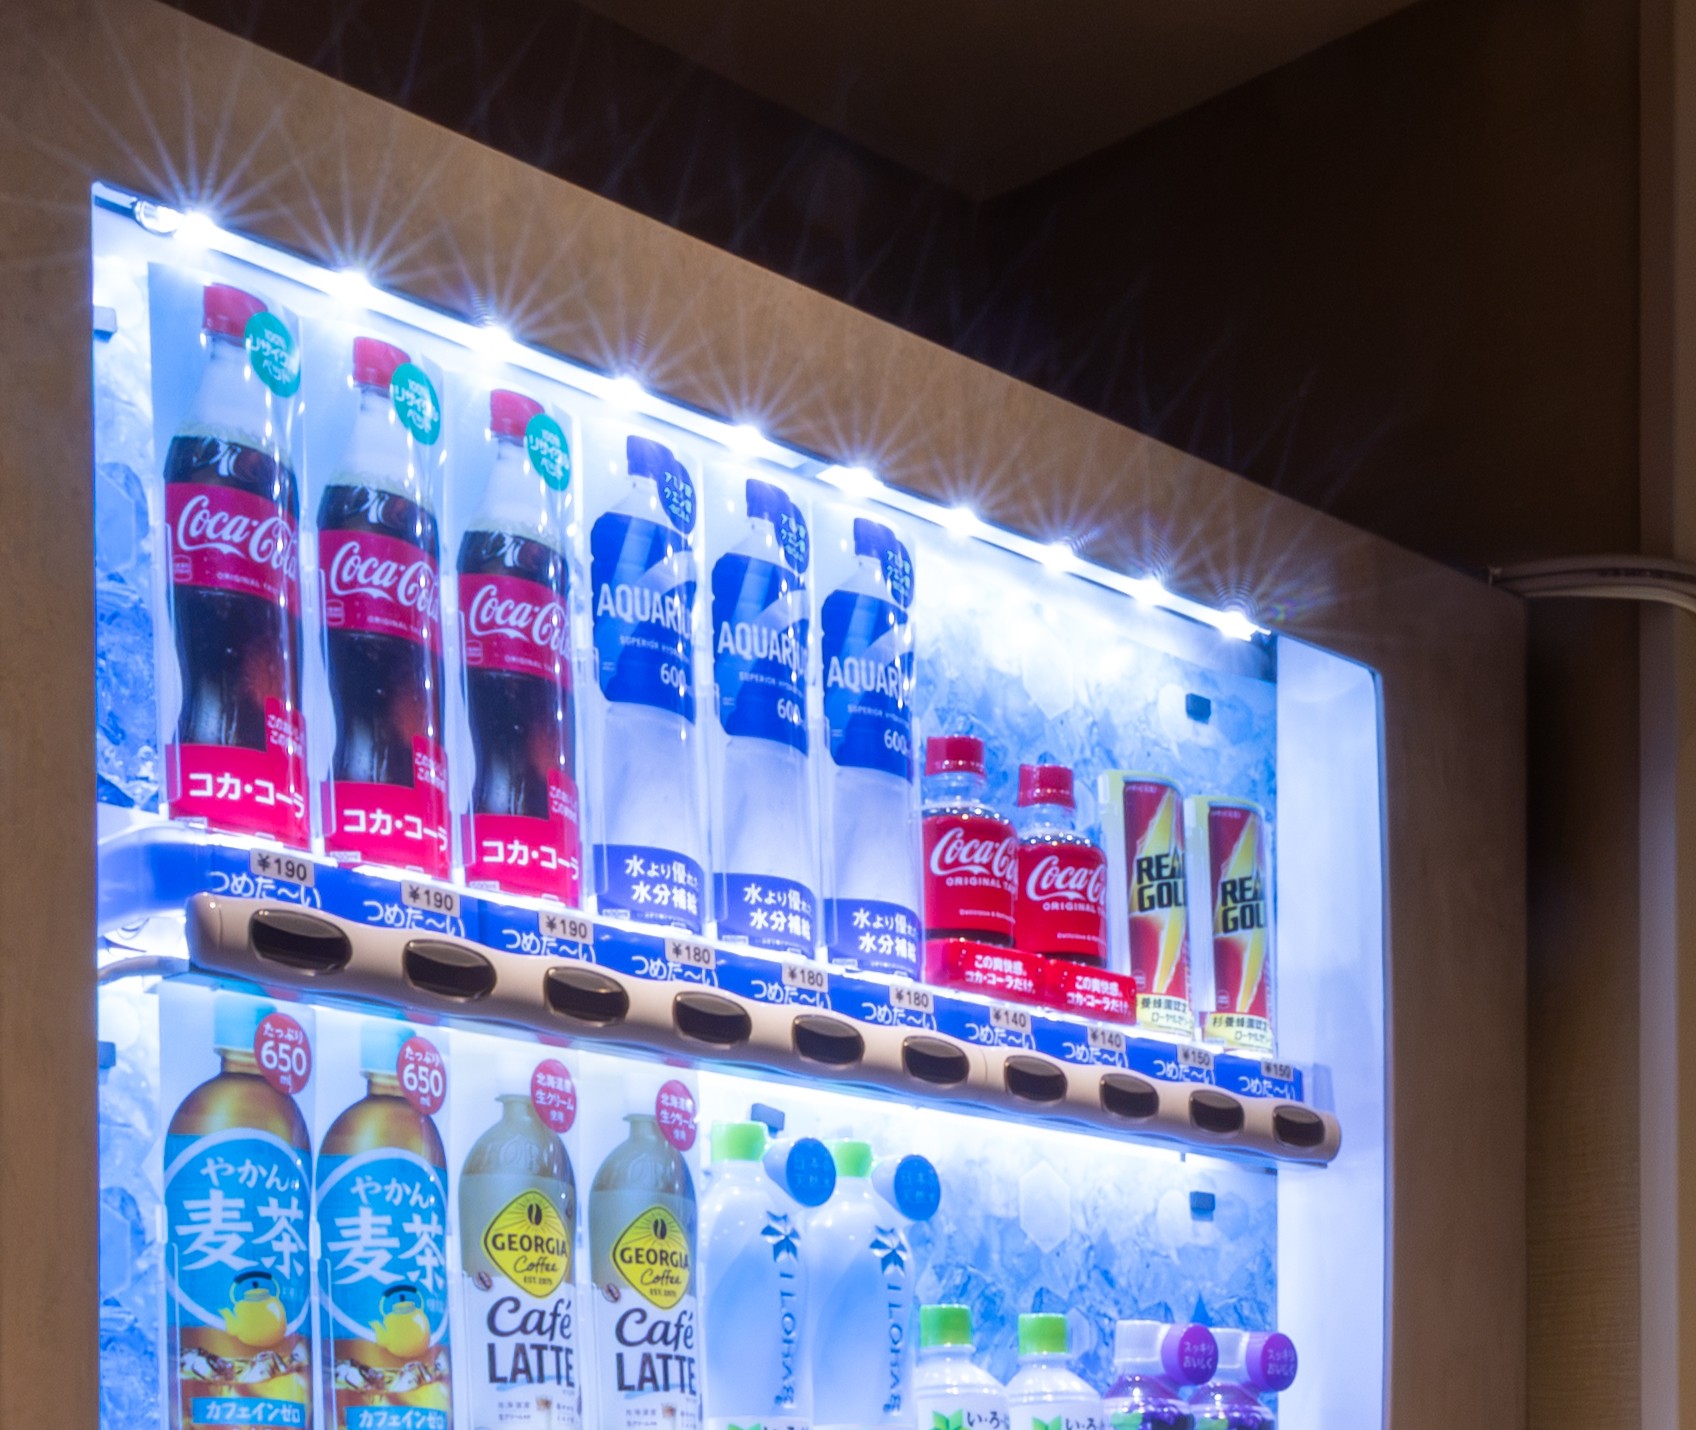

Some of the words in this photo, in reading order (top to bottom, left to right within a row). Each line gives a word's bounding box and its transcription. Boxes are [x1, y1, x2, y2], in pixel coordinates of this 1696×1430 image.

[261, 1040, 307, 1077] 650
[403, 1063, 443, 1097] 650
[174, 1188, 307, 1280] 麦茶
[326, 1206, 446, 1293] 麦茶
[491, 1232, 568, 1258] GEORGIA
[619, 1247, 690, 1271] GEORGIA
[487, 1296, 572, 1341] Café
[615, 1307, 695, 1352] Café
[487, 1343, 575, 1388] LATTE
[616, 1352, 697, 1396] LATTE
[205, 1401, 301, 1424] カフェインゼロ
[359, 1409, 446, 1430] カフェインゼロ
